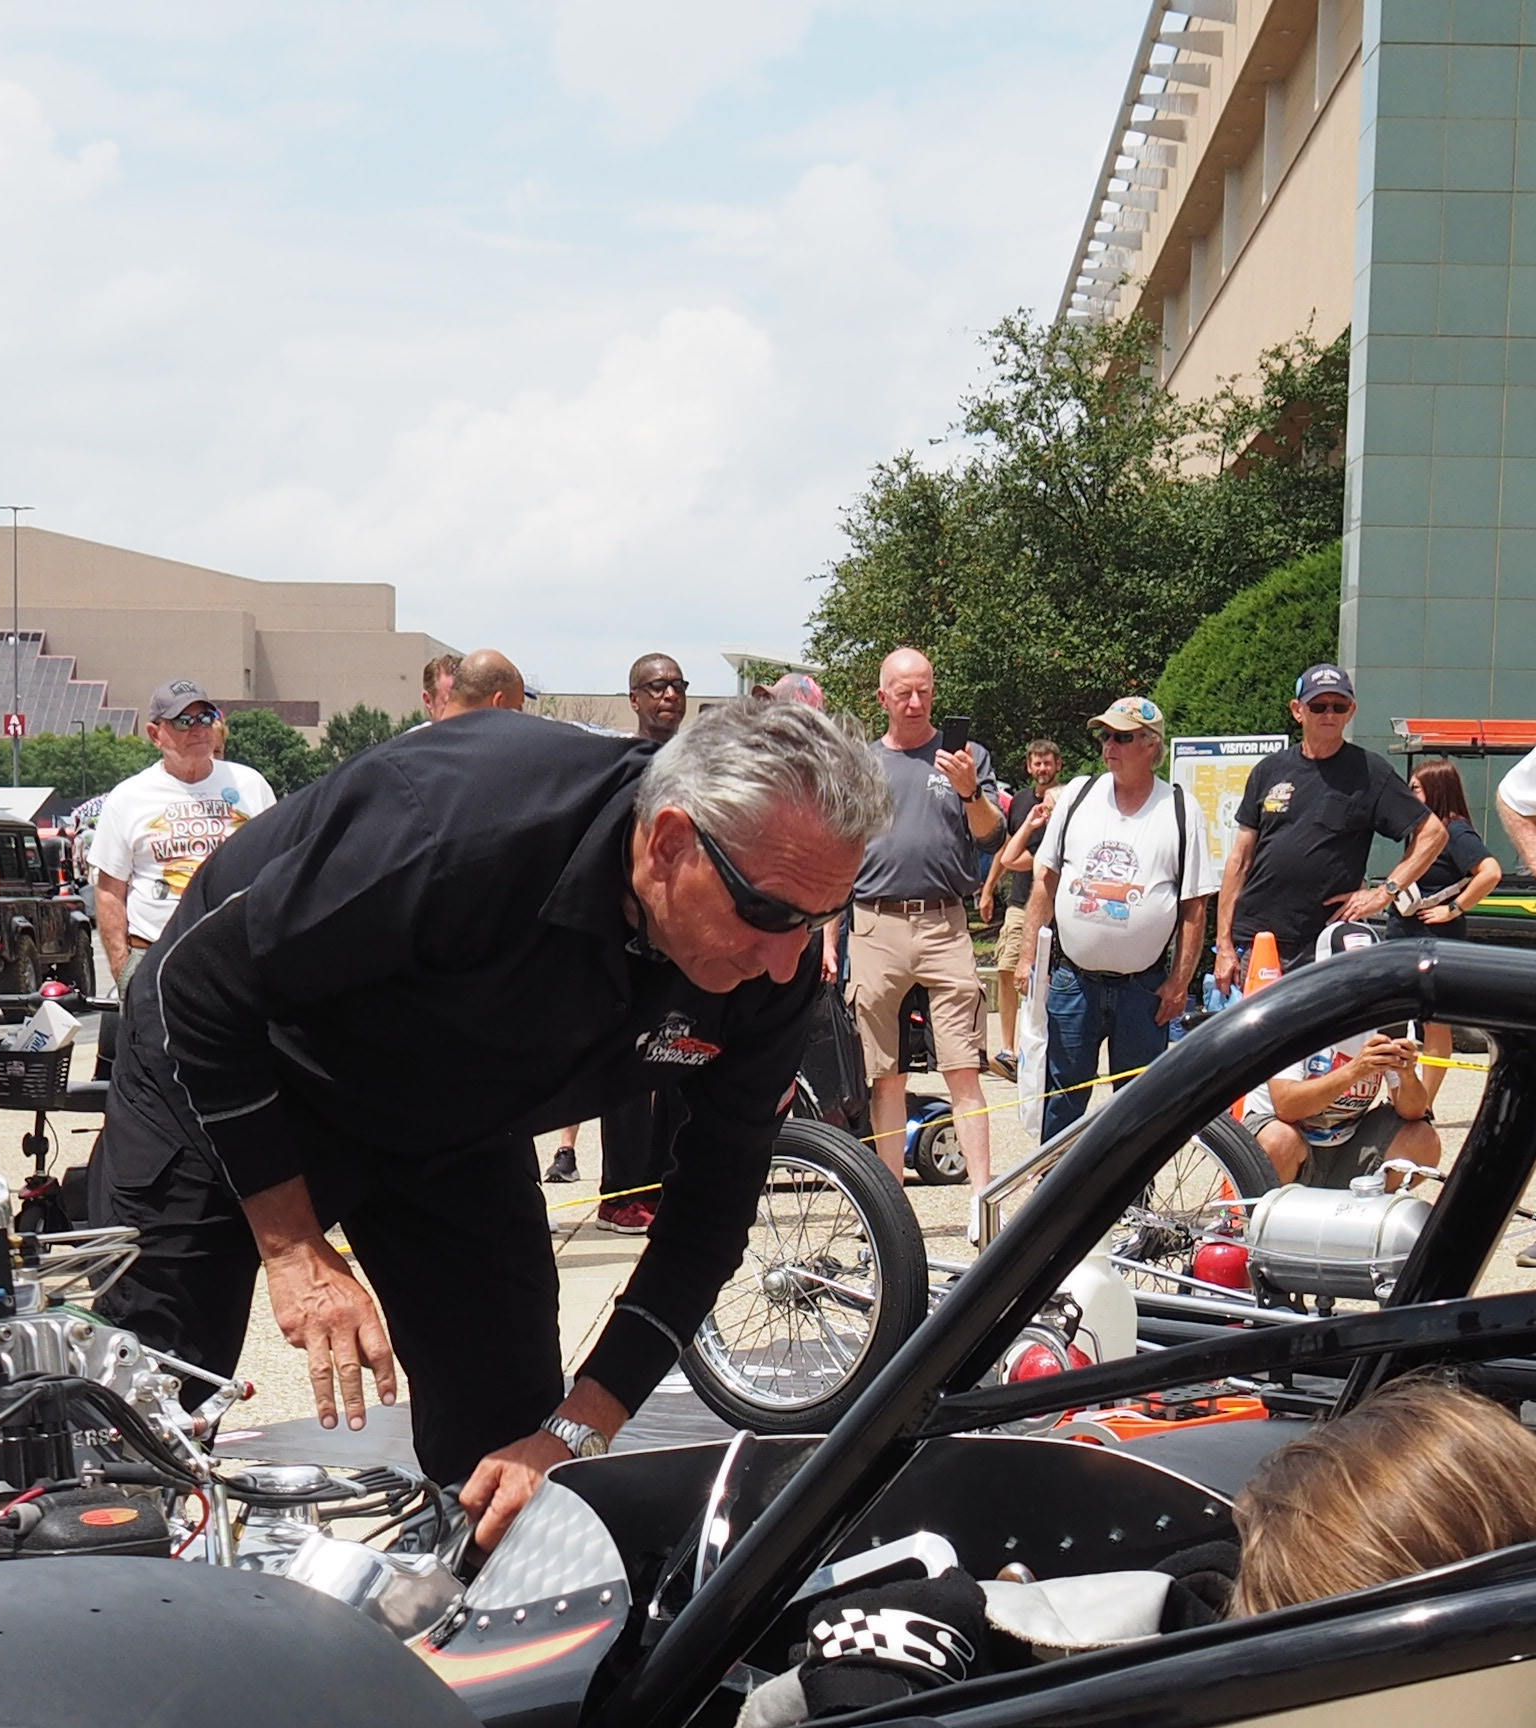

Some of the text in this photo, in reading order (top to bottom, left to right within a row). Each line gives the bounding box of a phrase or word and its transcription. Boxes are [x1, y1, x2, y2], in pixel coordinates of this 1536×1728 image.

[1219, 743, 1258, 754] VISITOR
[1259, 742, 1282, 753] MAP
[164, 800, 231, 820] STREET
[171, 819, 224, 838] ROD
